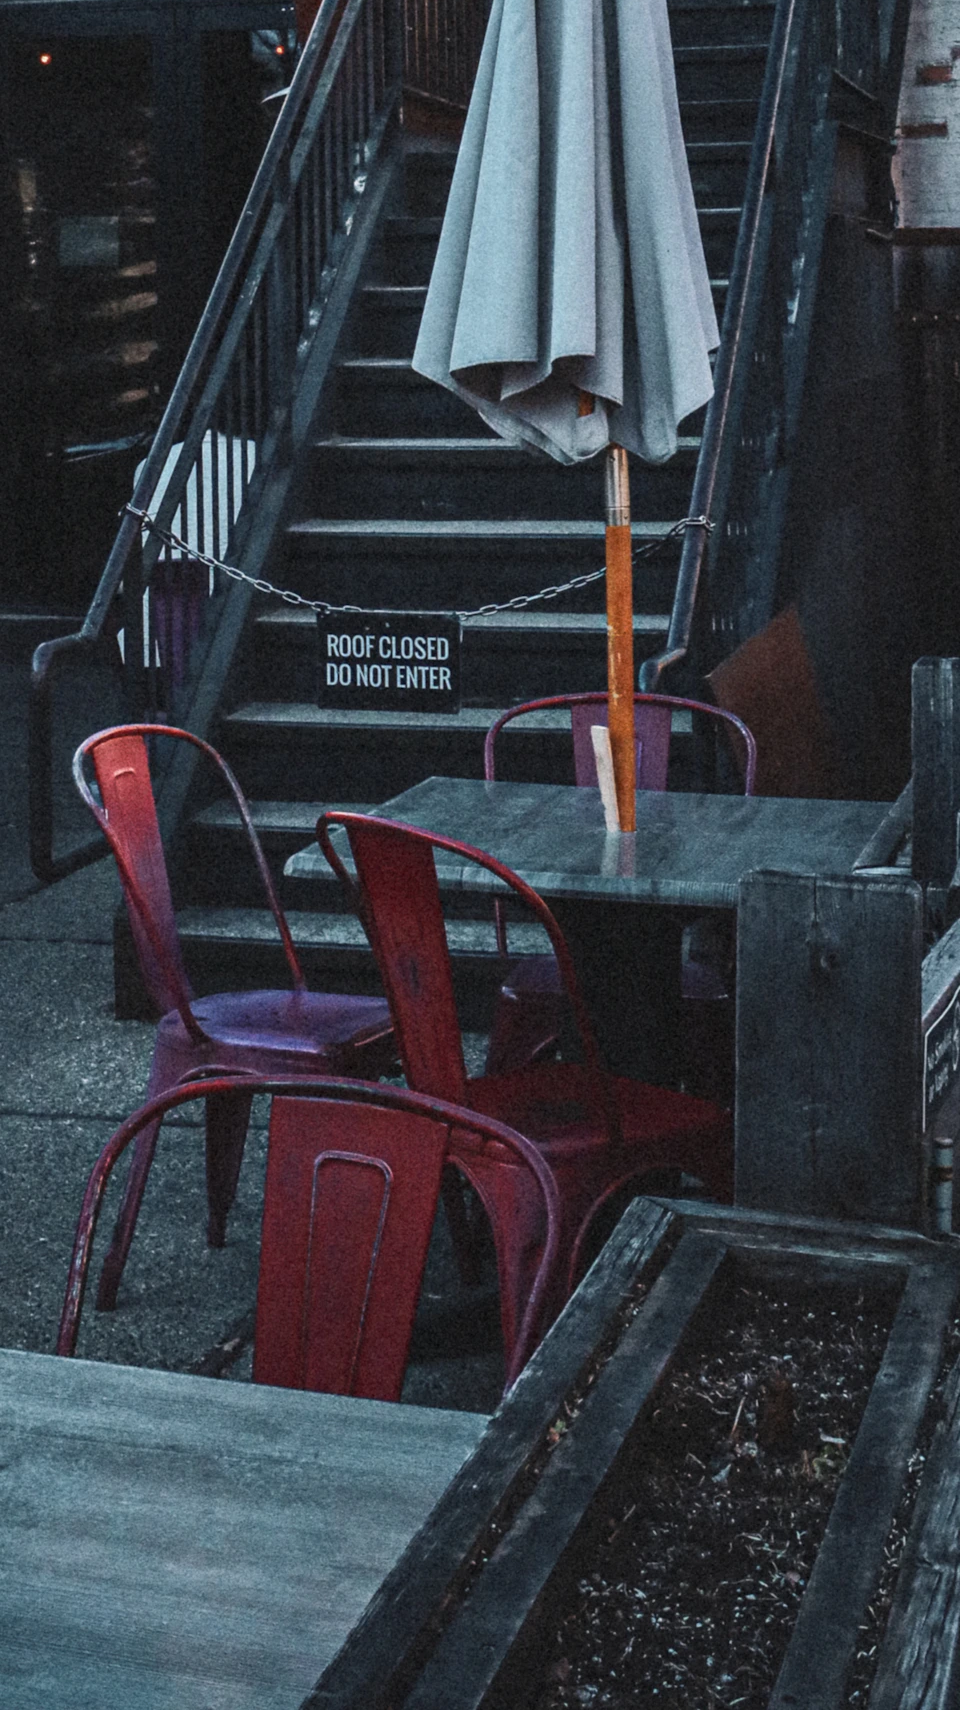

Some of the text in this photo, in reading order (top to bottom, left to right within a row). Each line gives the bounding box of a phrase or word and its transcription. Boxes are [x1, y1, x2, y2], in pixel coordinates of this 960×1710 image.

[327, 634, 449, 661] ROOF CLOSED
[326, 663, 452, 690] DO NOT ENTER
